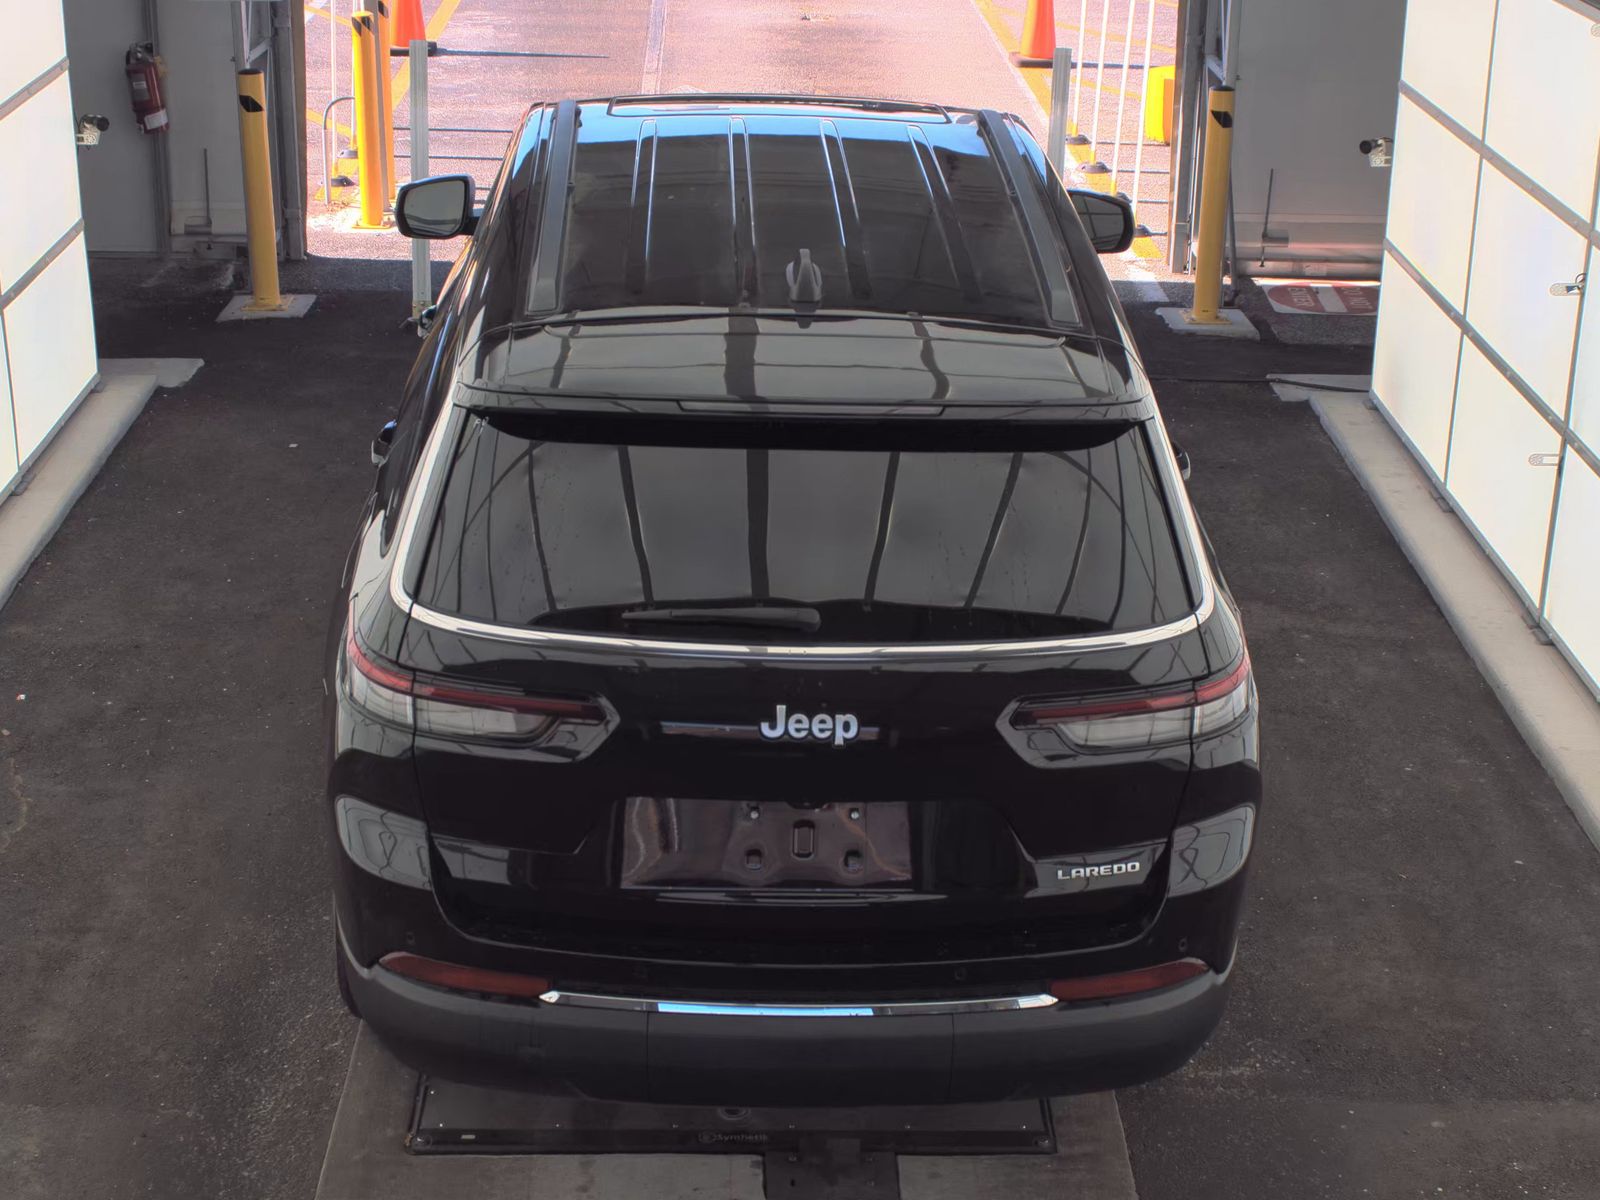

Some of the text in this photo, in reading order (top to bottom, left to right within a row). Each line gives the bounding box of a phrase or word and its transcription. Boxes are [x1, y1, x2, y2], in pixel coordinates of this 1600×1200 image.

[1287, 287, 1315, 306] ENTER
[760, 704, 859, 746] Jeep
[1057, 861, 1140, 880] LAREDO
